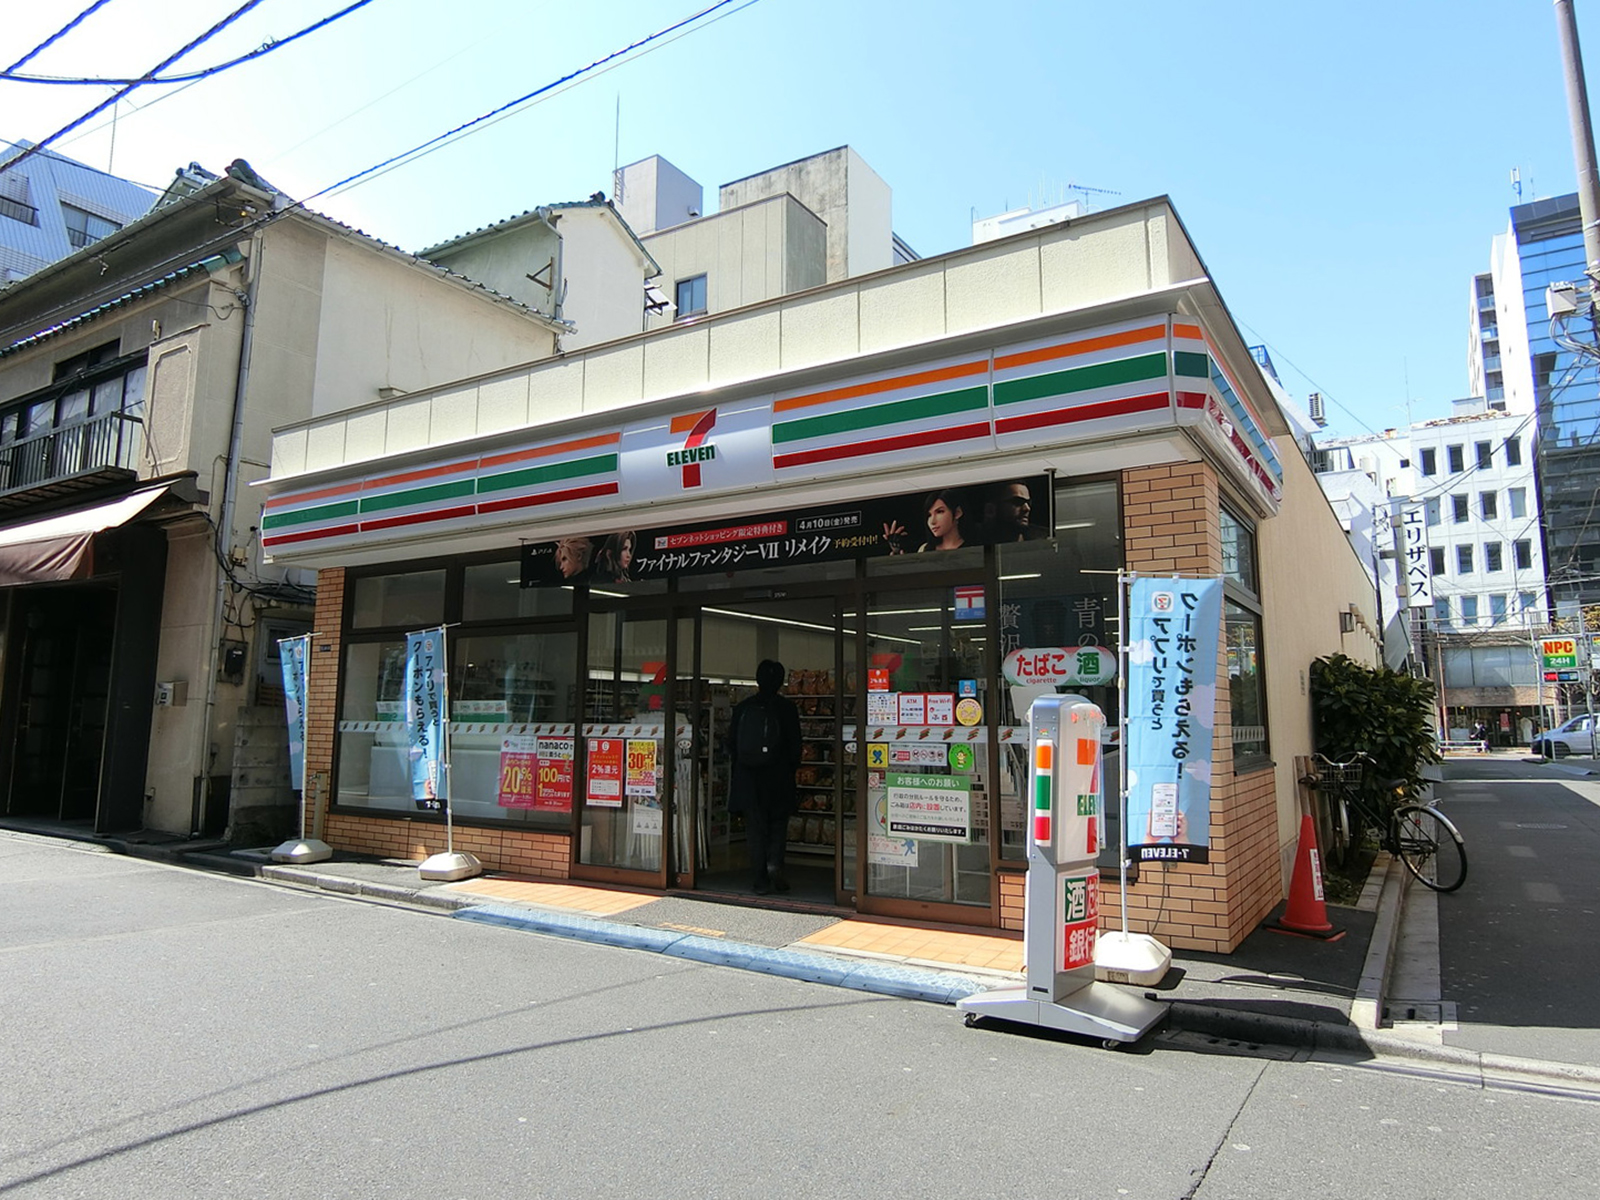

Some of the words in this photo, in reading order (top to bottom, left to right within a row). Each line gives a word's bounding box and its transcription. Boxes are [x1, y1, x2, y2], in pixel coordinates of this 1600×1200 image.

[799, 515, 859, 530] 4月10日(金)発売
[670, 524, 783, 545] セブンネットショッピング限定特典付き
[785, 535, 832, 558] リメイク
[1403, 510, 1428, 598] エリザベス
[1543, 641, 1573, 654] NPC
[1016, 653, 1067, 677] たばこ
[1076, 652, 1100, 675] 酒
[538, 741, 569, 750] nanaco
[502, 765, 533, 794] 20%
[897, 776, 960, 787] お客様へのお願い
[1067, 880, 1085, 920] 酒
[1069, 926, 1096, 963] 銀行
